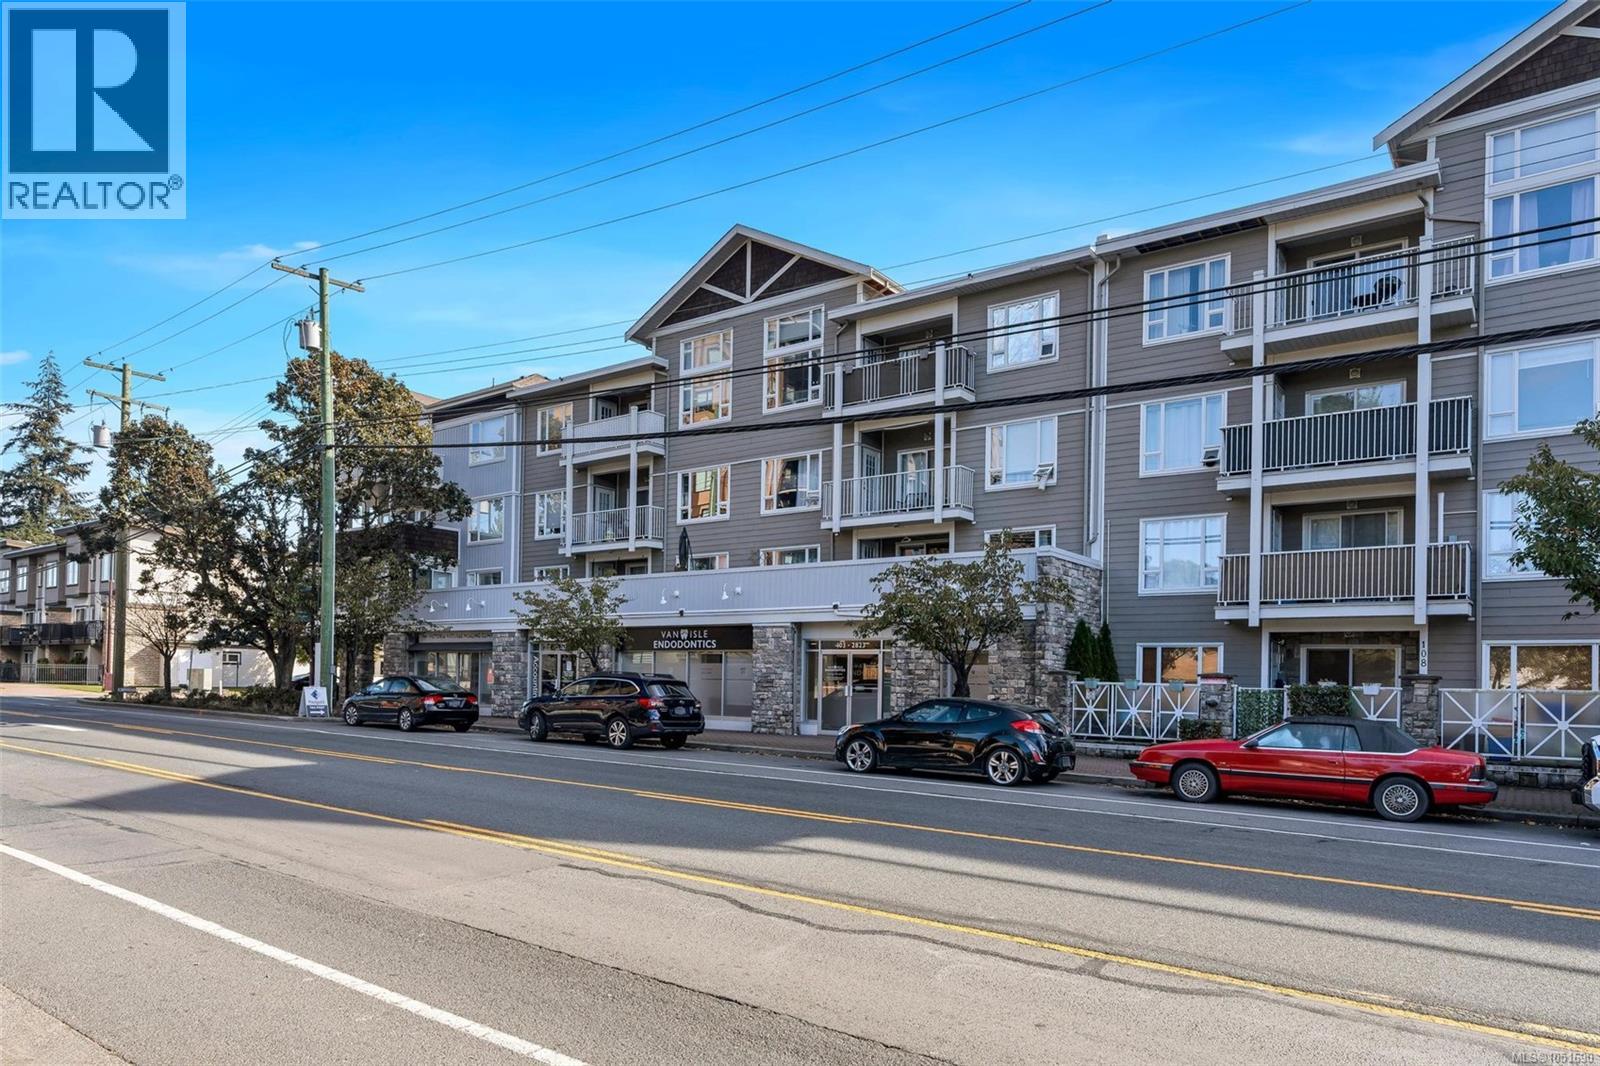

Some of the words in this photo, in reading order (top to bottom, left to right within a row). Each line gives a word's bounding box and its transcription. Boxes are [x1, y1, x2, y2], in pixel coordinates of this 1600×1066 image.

[661, 630, 679, 639] VAN
[690, 629, 708, 638] ISLE
[653, 639, 717, 649] ENDODONTICS
